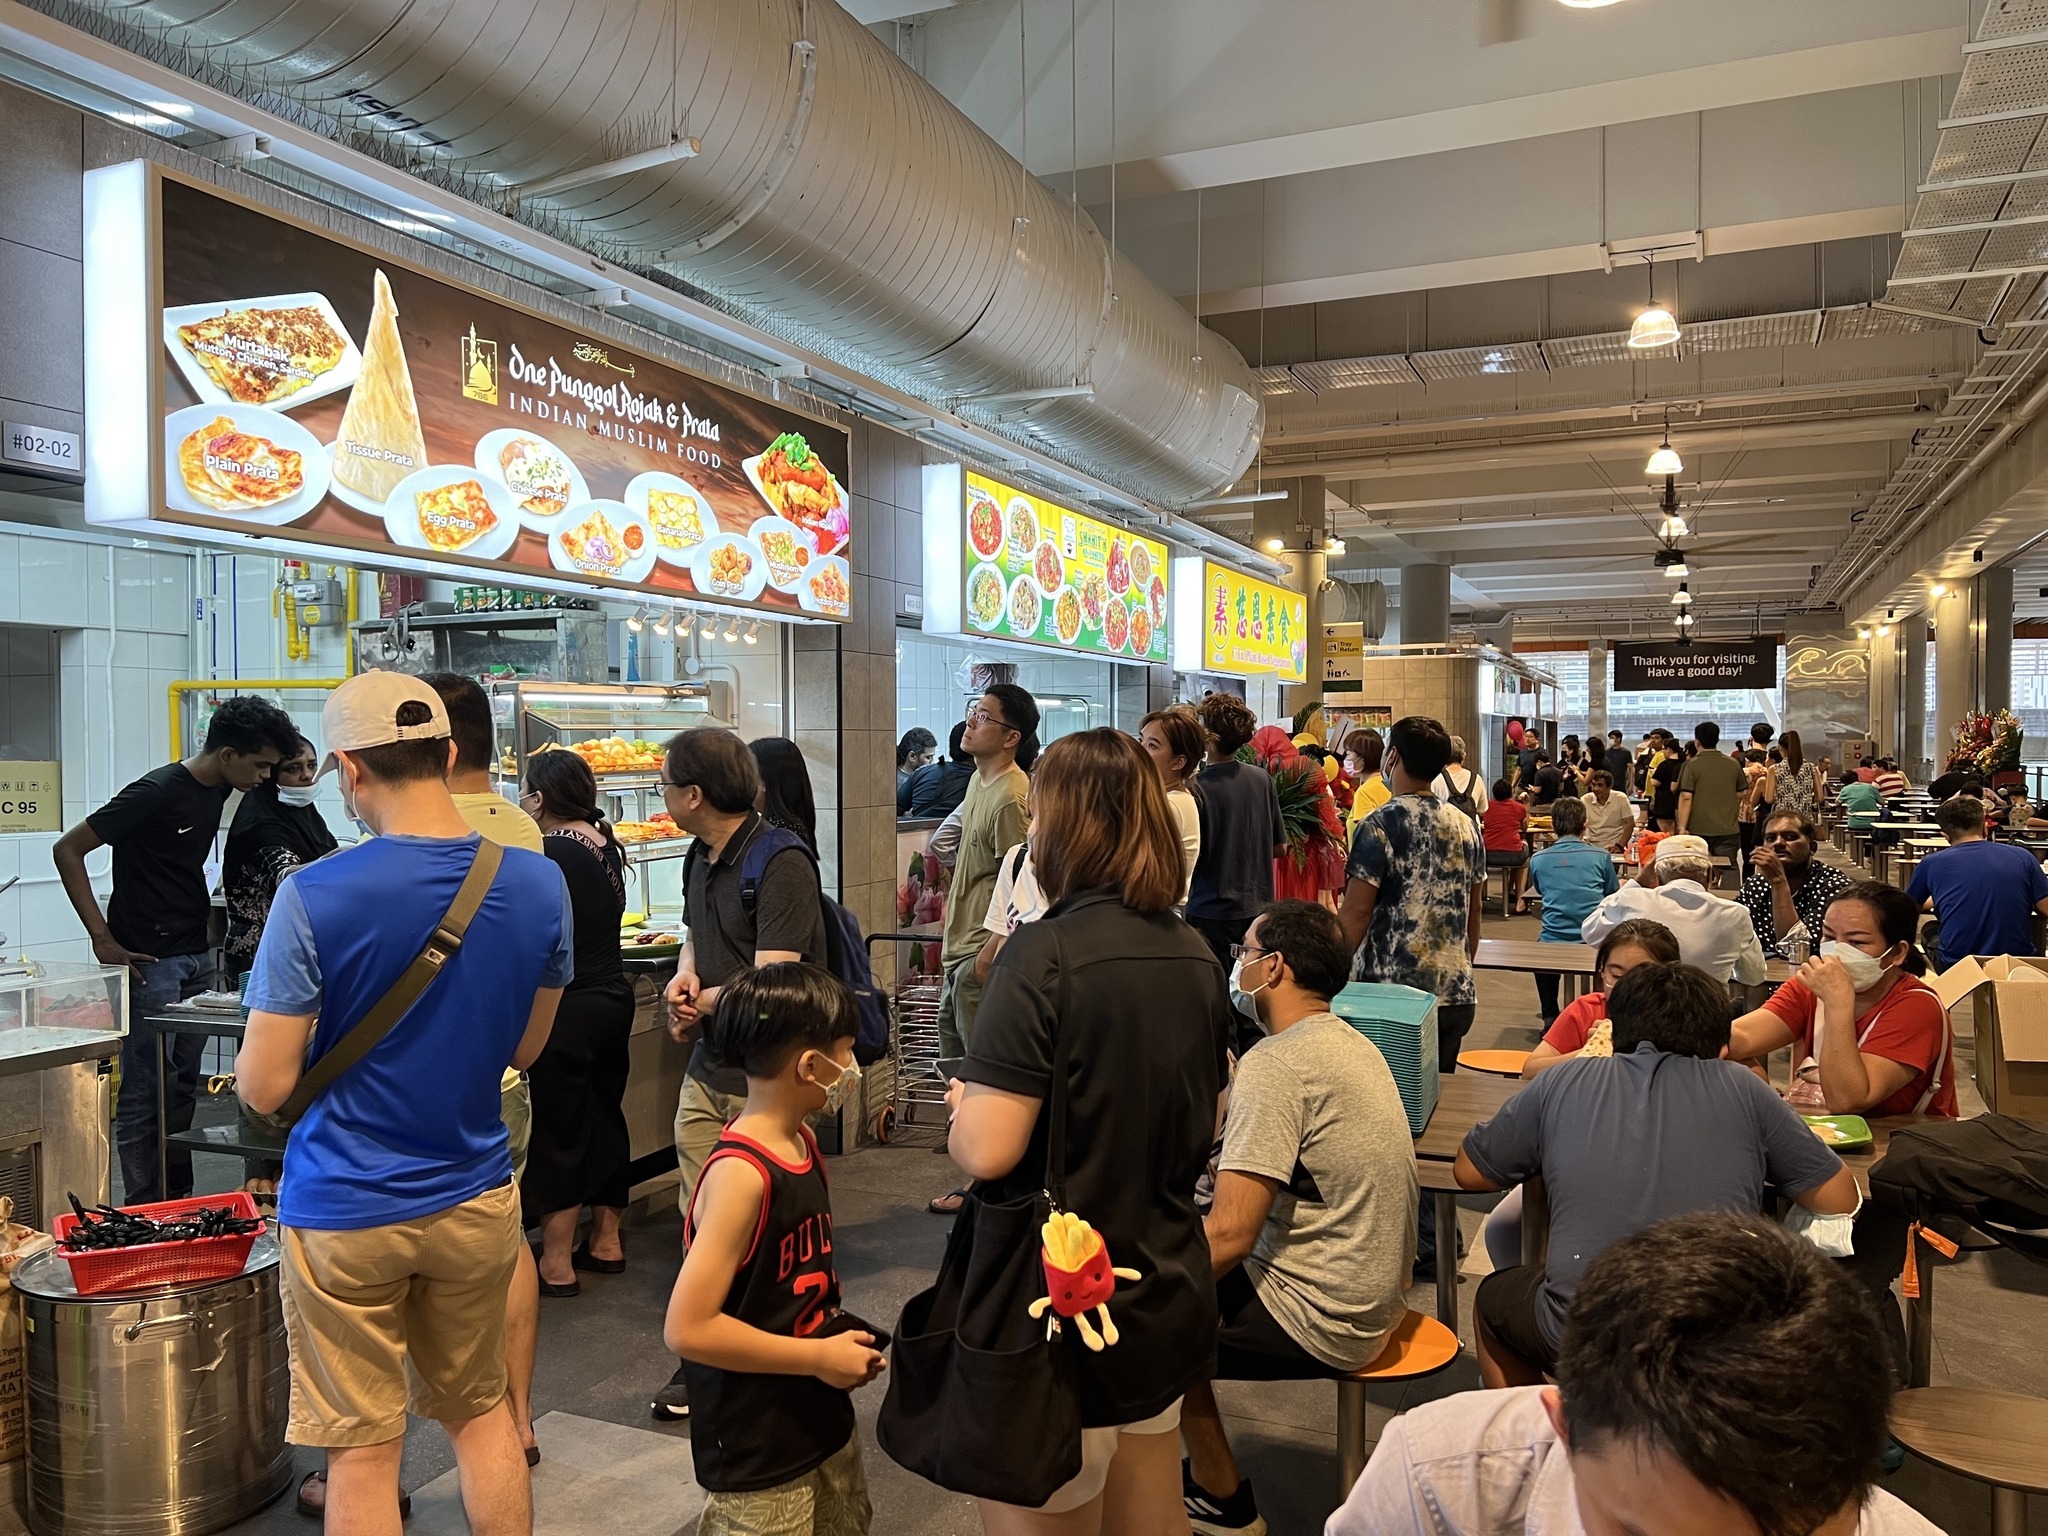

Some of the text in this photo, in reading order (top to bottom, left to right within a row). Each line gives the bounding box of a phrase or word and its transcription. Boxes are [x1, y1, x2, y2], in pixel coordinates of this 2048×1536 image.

[224, 333, 290, 362] Murtabak
[194, 341, 316, 380] Mutton, Chicken, Sardine
[473, 391, 489, 401] 786
[509, 343, 547, 386] One
[547, 356, 619, 415] Punggol
[614, 380, 664, 424] Rojak
[666, 402, 679, 428] &
[681, 401, 720, 442] Prata
[509, 392, 721, 469] INDIAN MUSLIM FOOD
[12, 433, 71, 458] #02-02
[345, 441, 414, 467] Tissue Prata
[205, 454, 280, 480] Plain Prata
[510, 481, 568, 503] Cheese Prata
[427, 511, 476, 530] Egg Prata
[656, 524, 702, 542] Banana Prata
[575, 559, 621, 576] Onion Prata
[769, 560, 800, 574] Mushroom
[776, 569, 792, 580] Prata
[711, 578, 743, 592] Coin Prata
[1214, 585, 1228, 636] 素
[1236, 586, 1291, 647] 慈恩素食
[1632, 653, 1758, 666] Thank you for visiting.
[1647, 665, 1743, 678] Have a good day!
[1, 801, 37, 814] C 95
